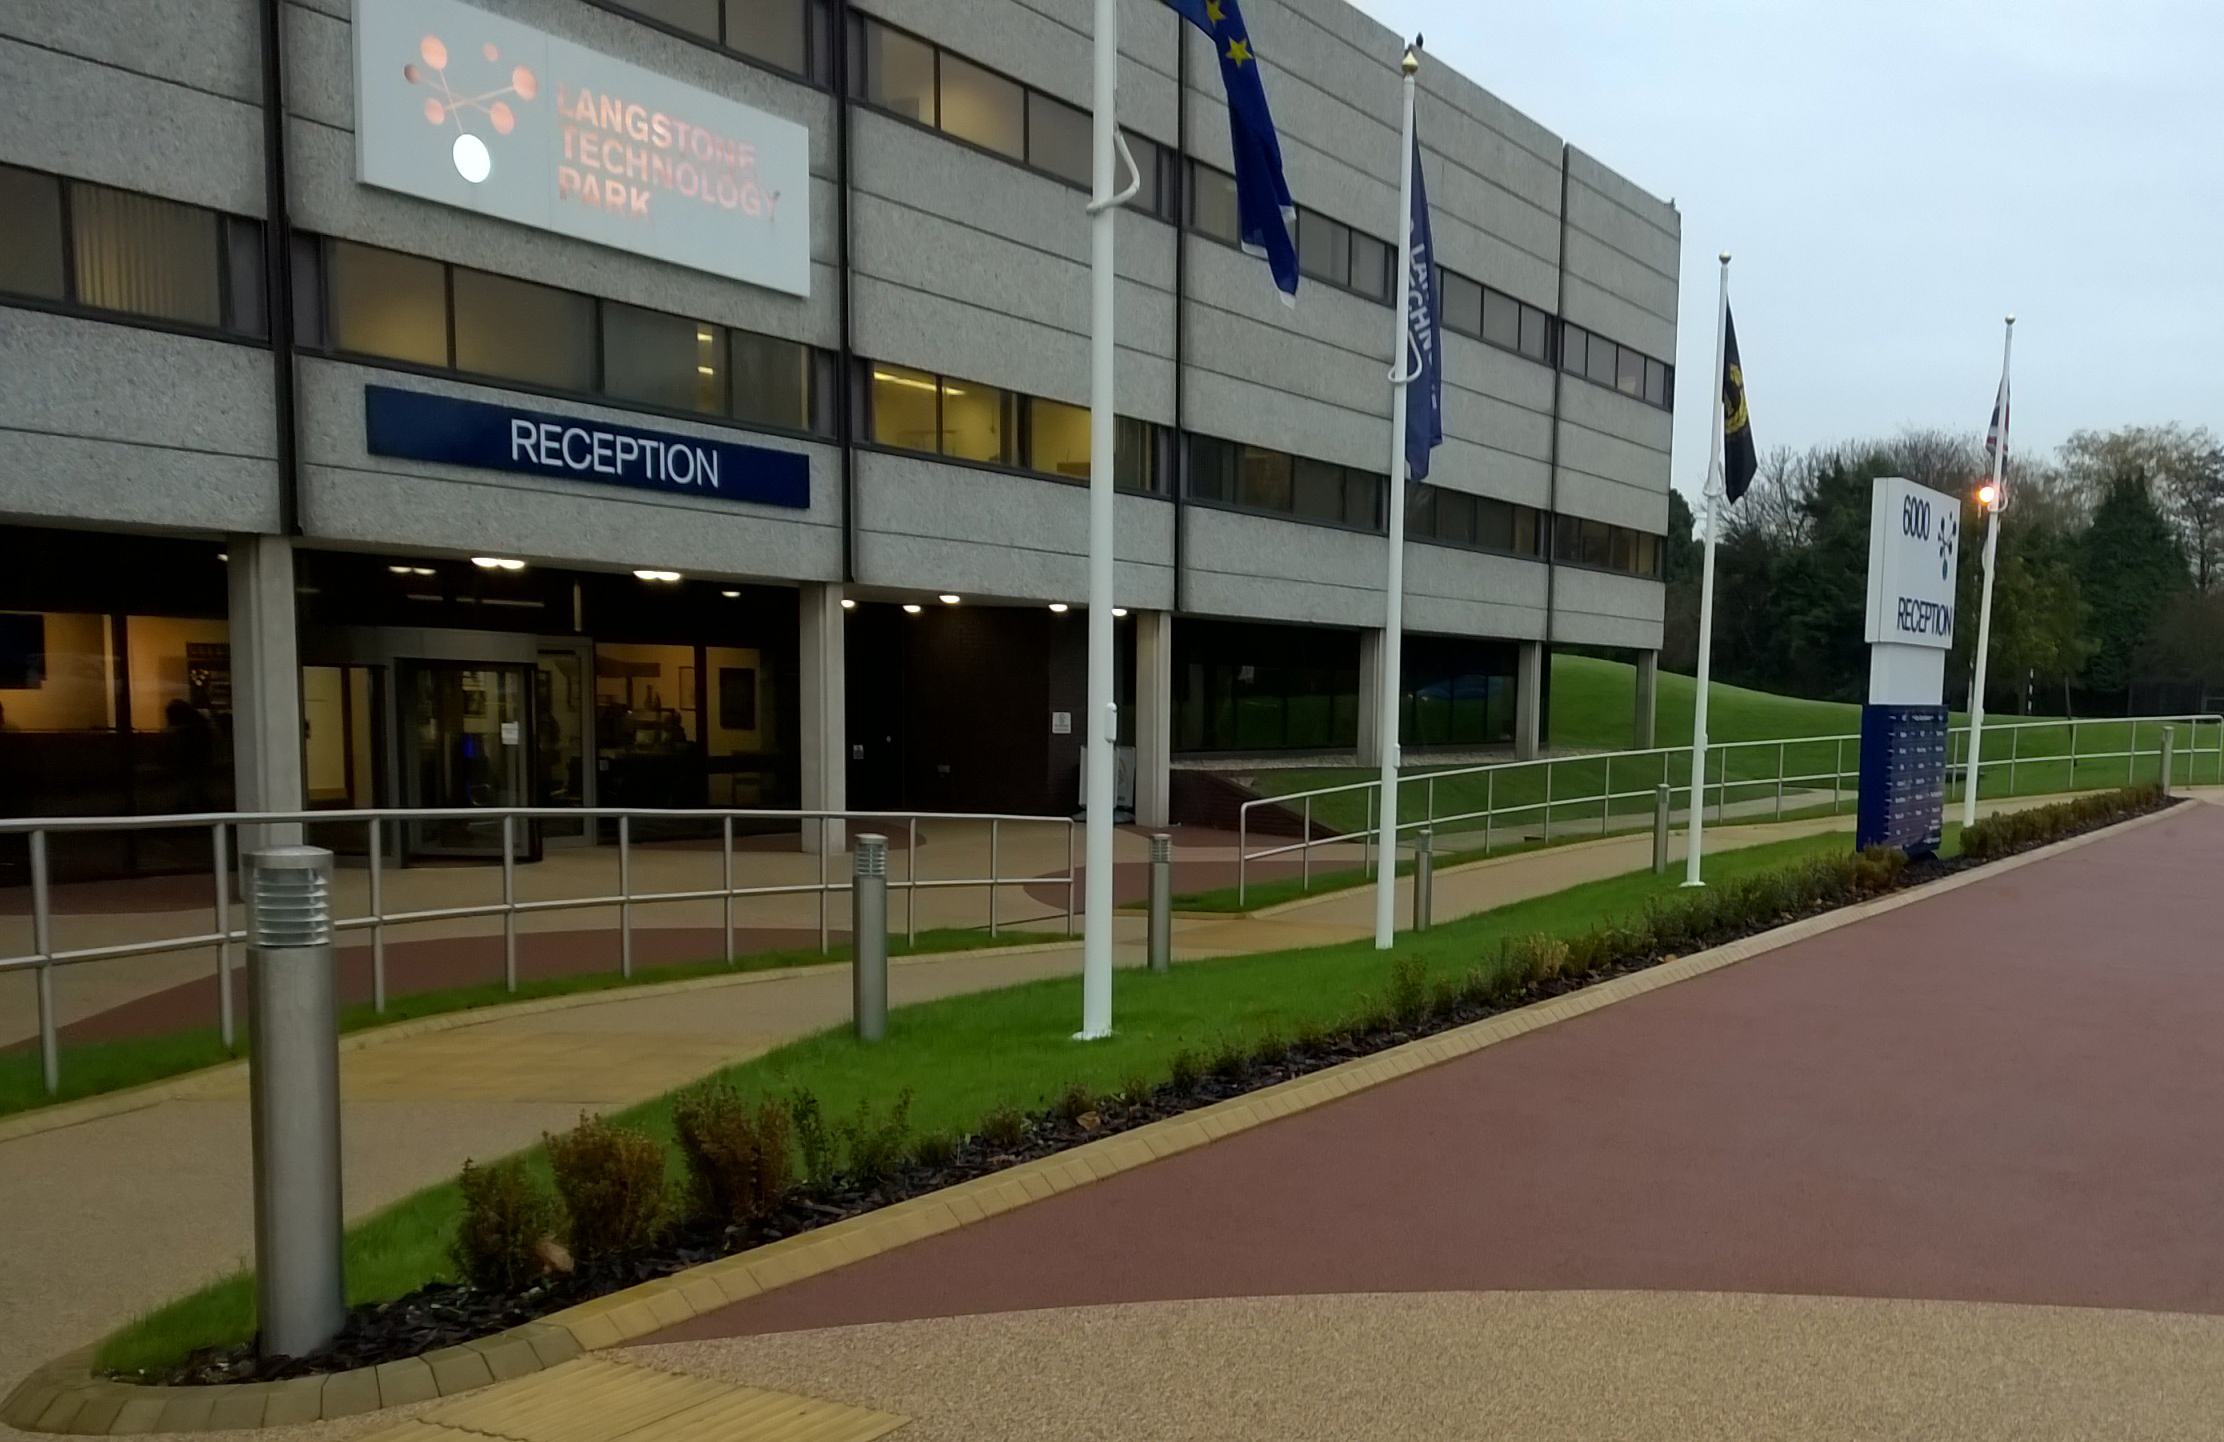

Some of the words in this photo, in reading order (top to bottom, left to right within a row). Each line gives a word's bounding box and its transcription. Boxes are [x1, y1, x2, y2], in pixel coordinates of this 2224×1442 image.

[557, 80, 756, 172] LANGSTONE
[558, 125, 780, 222] TECHNOLOGY
[558, 165, 652, 219] PARK
[511, 418, 719, 488] RECEPTION
[1902, 493, 1931, 541] 6000
[1896, 596, 1952, 636] RECEPTION
